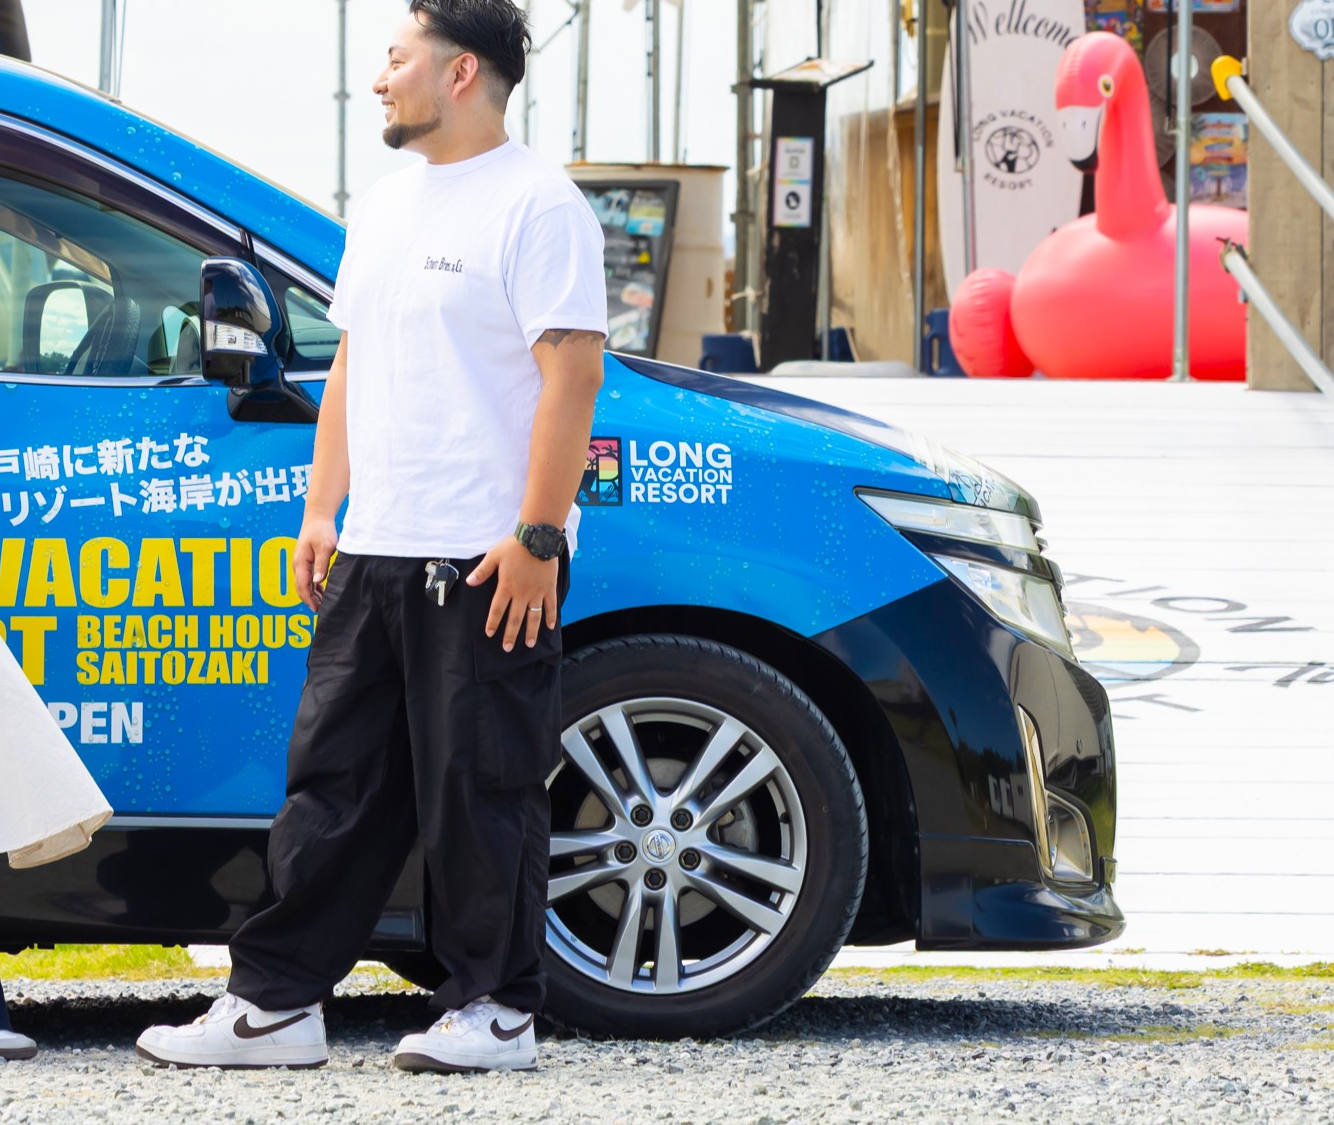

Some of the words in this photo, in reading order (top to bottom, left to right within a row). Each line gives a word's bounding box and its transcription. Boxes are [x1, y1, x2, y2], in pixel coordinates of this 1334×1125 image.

[999, 109, 1055, 148] VACATION
[984, 173, 1034, 191] RESORT
[629, 440, 733, 469] LONG
[630, 467, 733, 484] VACATION
[630, 482, 733, 505] RESORT
[77, 614, 192, 649] BEACH
[209, 614, 318, 649] HOUS
[76, 650, 269, 685] SAITOZAKI
[47, 701, 144, 745] PEN
